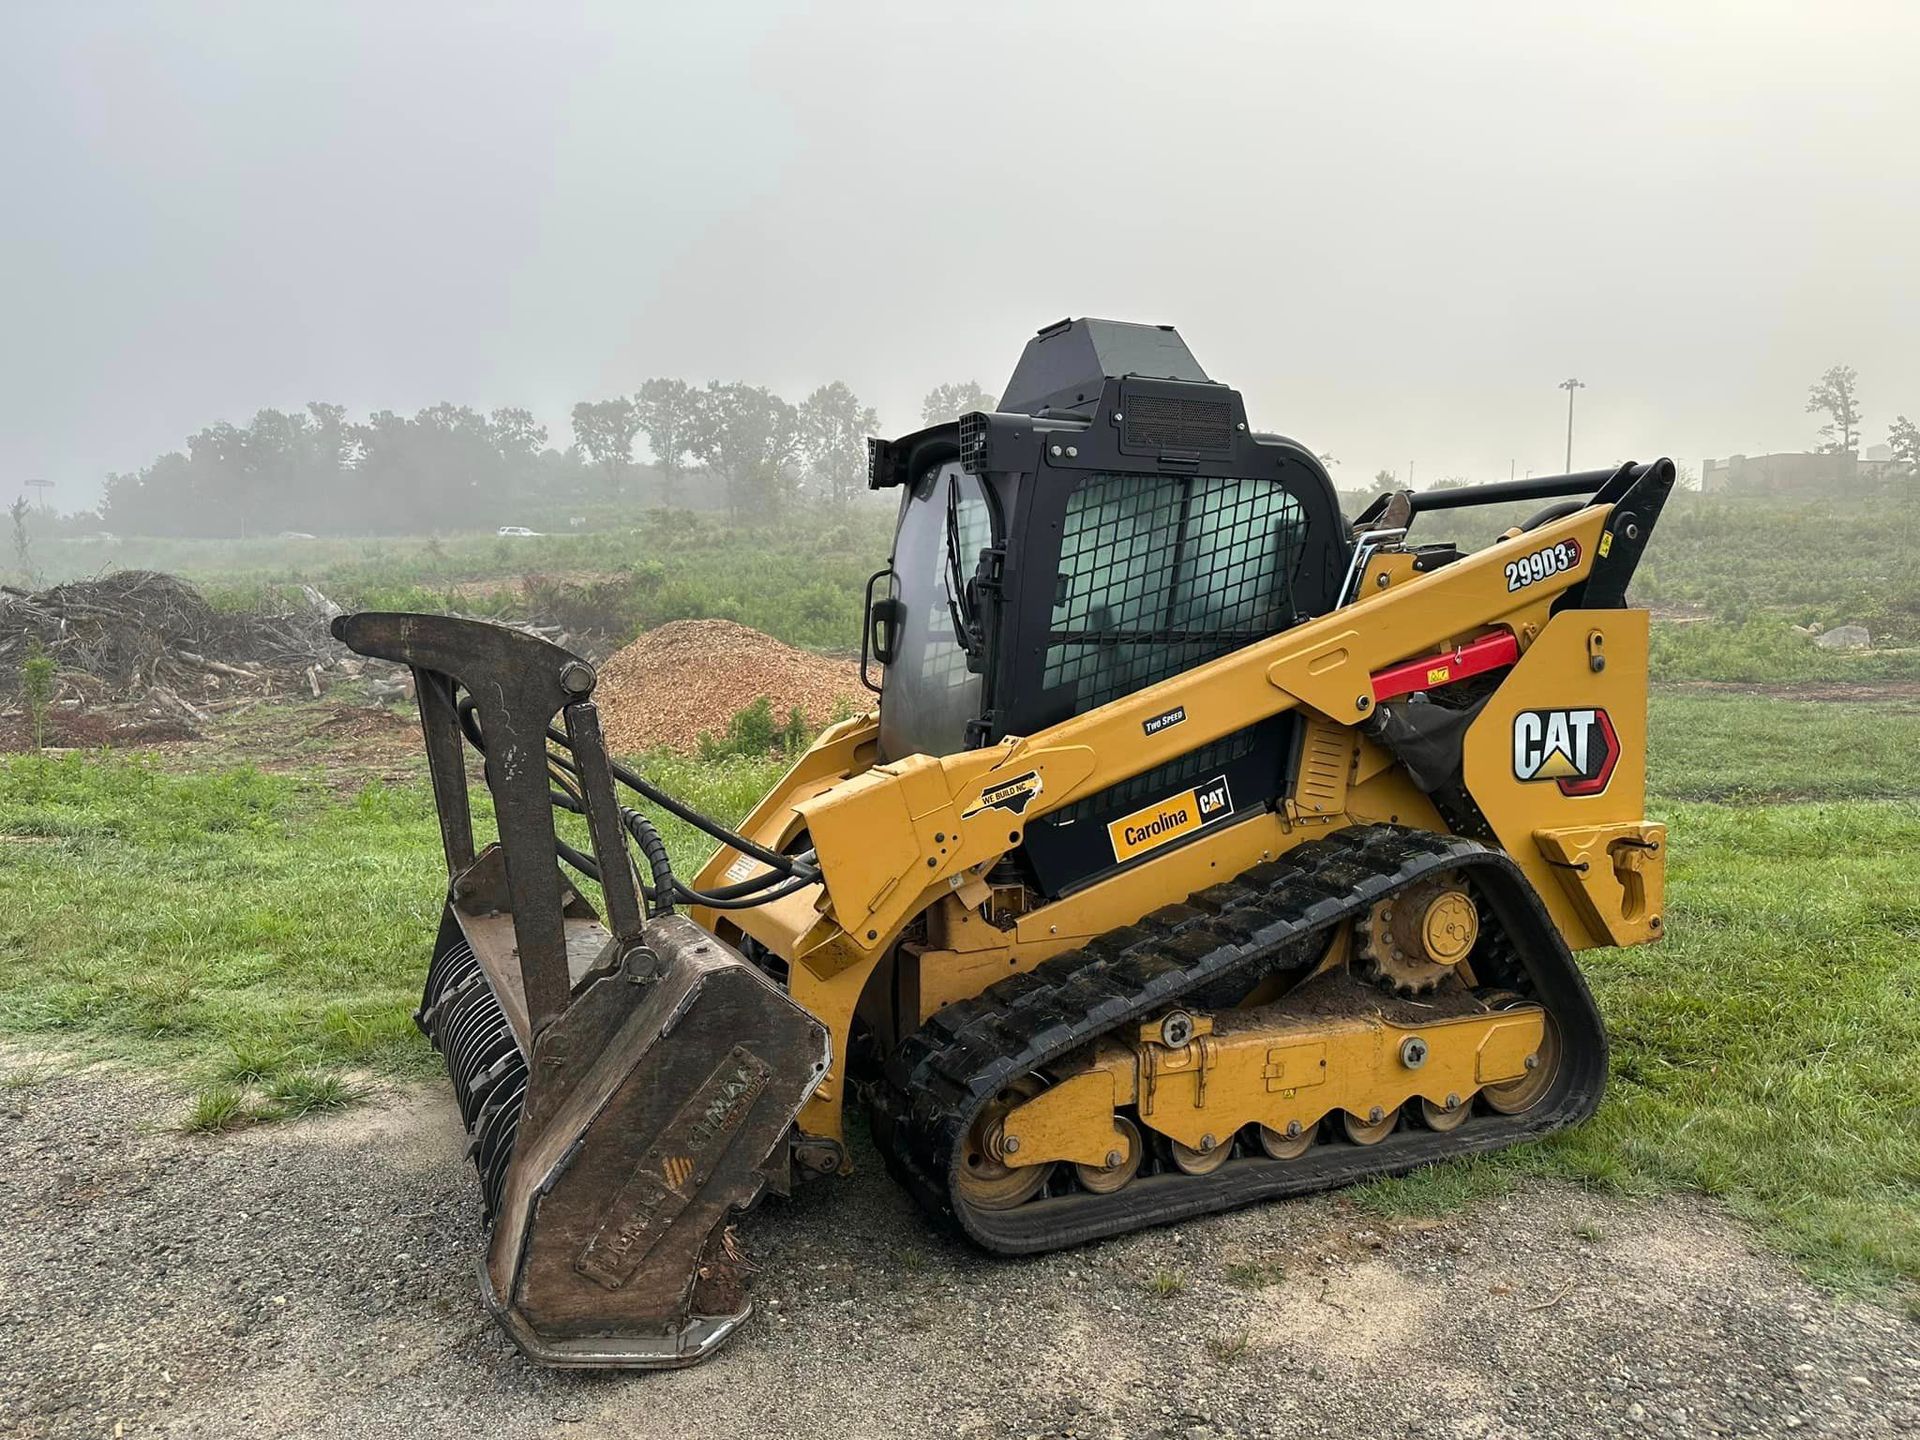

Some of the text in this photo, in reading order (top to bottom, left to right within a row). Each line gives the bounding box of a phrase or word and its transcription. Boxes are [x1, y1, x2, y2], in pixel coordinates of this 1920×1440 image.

[1506, 543, 1569, 591] 299D3
[1515, 710, 1595, 779] CAT
[982, 783, 1027, 805] WE BUILD NC
[1124, 787, 1225, 846] Carolina CAT
